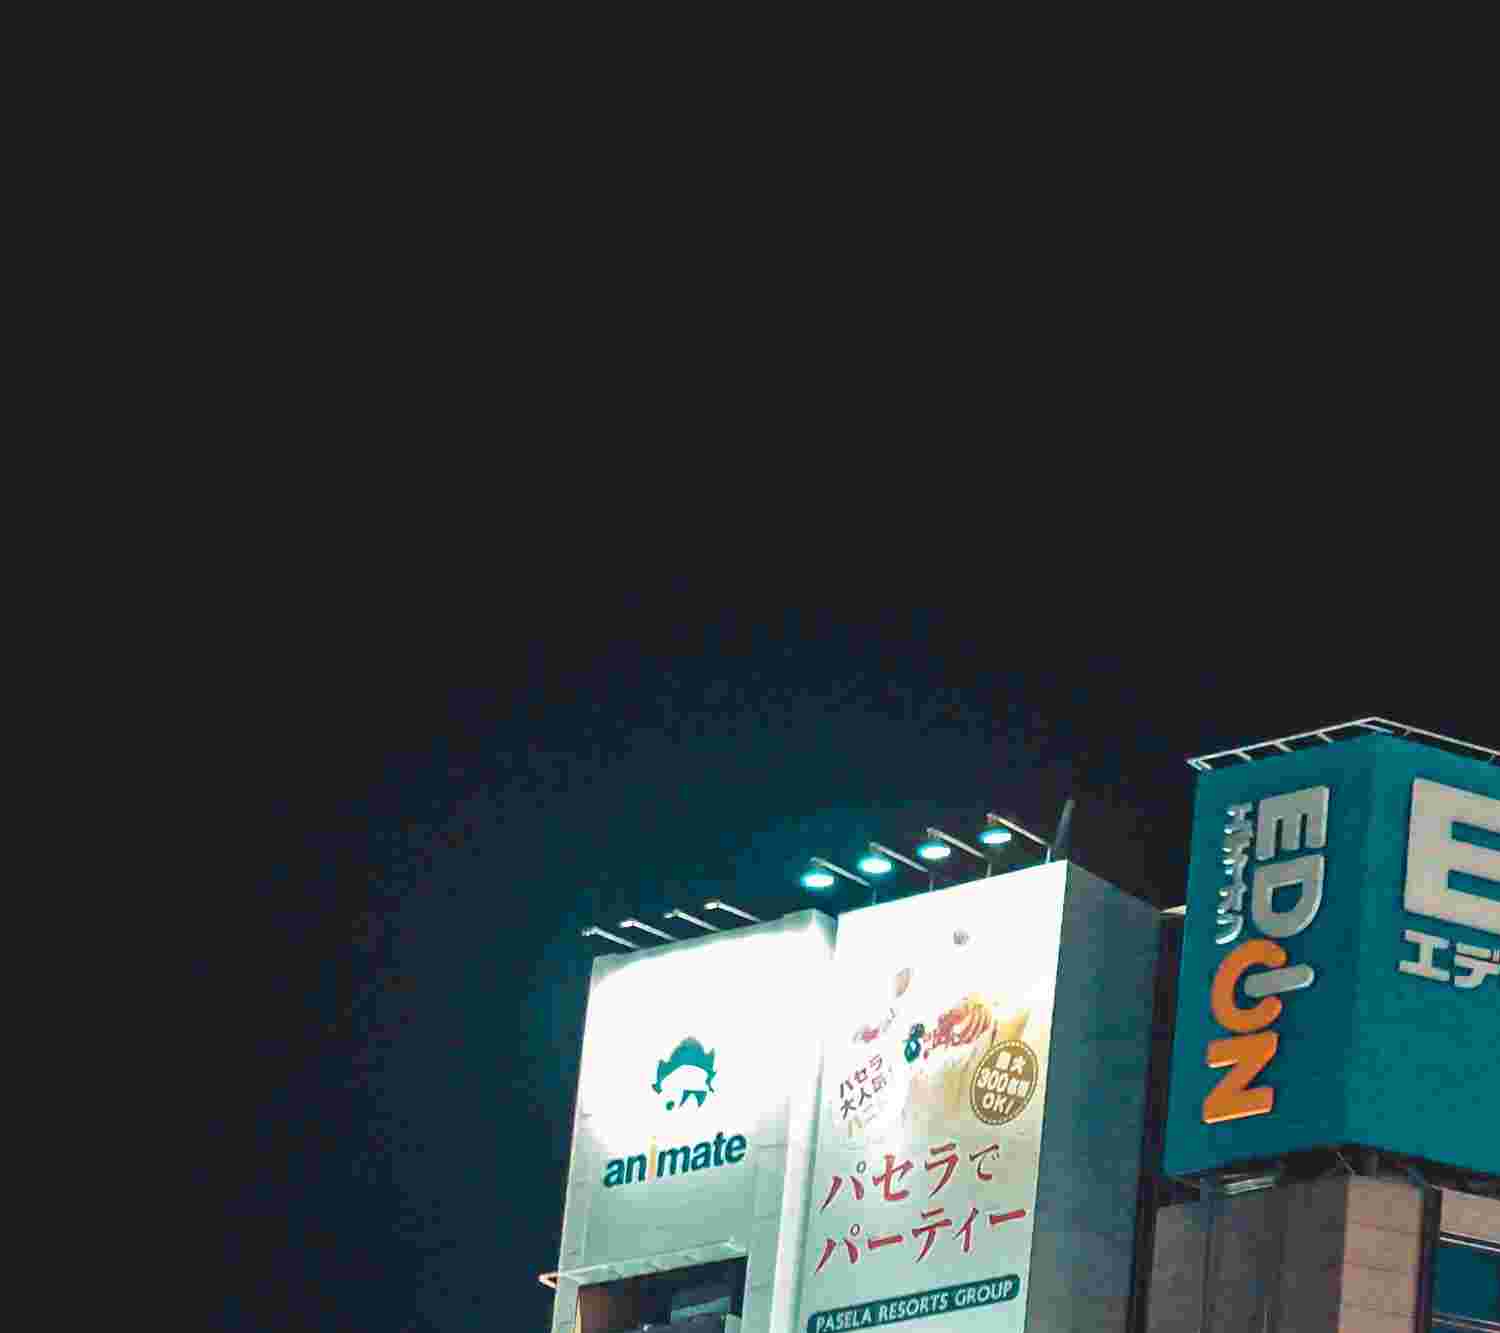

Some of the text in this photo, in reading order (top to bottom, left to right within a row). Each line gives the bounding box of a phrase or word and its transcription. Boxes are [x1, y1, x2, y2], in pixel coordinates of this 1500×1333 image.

[601, 1129, 748, 1188] animate
[819, 1142, 1000, 1214] パセラで
[814, 1206, 1027, 1277] パーティー
[879, 1293, 949, 1322] RESORTS
[953, 1279, 1014, 1305] GROUP
